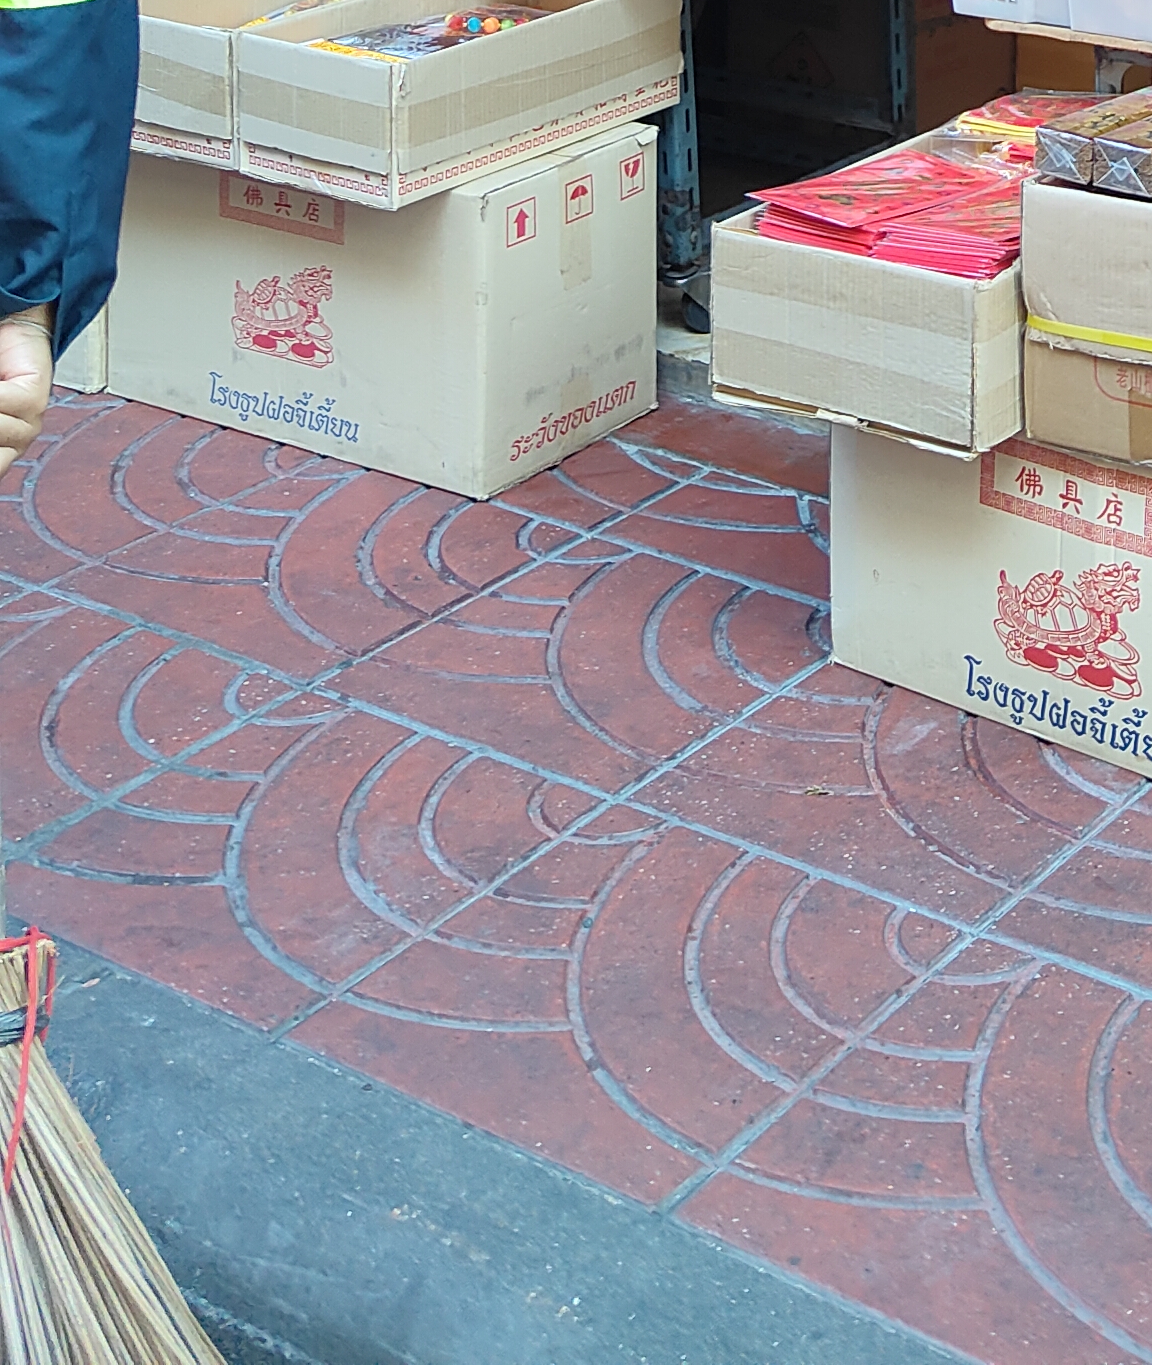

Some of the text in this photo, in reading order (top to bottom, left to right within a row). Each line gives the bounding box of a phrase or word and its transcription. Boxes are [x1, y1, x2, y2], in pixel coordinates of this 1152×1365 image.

[243, 183, 320, 224] 佛具店
[509, 380, 637, 462] ระวังของแตก
[1014, 465, 1126, 528] 佛具店
